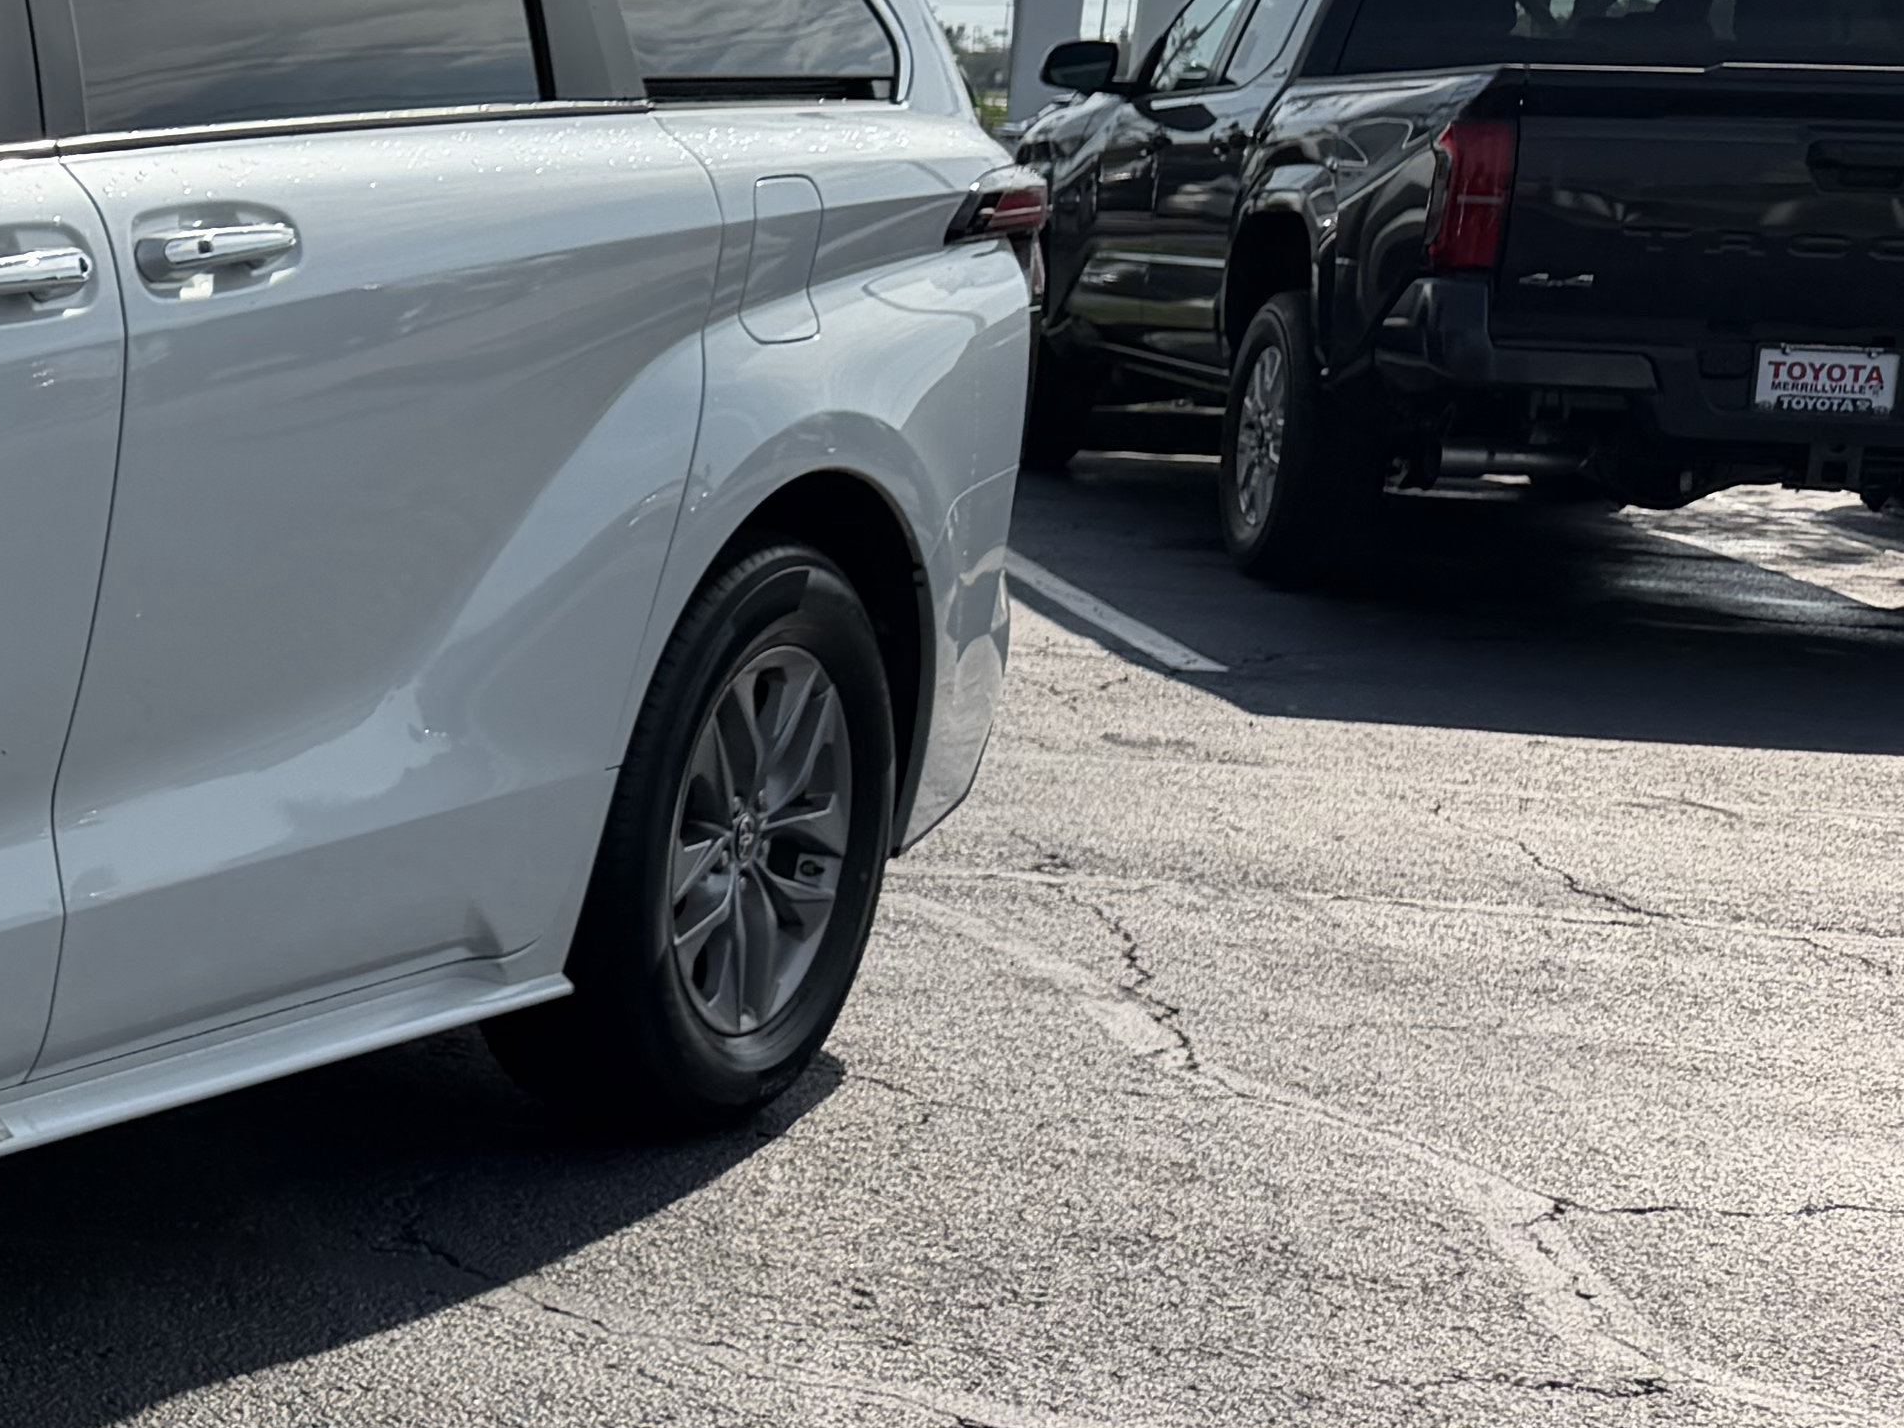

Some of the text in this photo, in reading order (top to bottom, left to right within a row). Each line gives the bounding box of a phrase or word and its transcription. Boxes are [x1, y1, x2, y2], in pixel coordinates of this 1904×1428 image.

[1768, 360, 1884, 384] TOYOTA
[1771, 381, 1866, 395] MERRILLVILLE
[1780, 396, 1854, 413] TOYOTA
